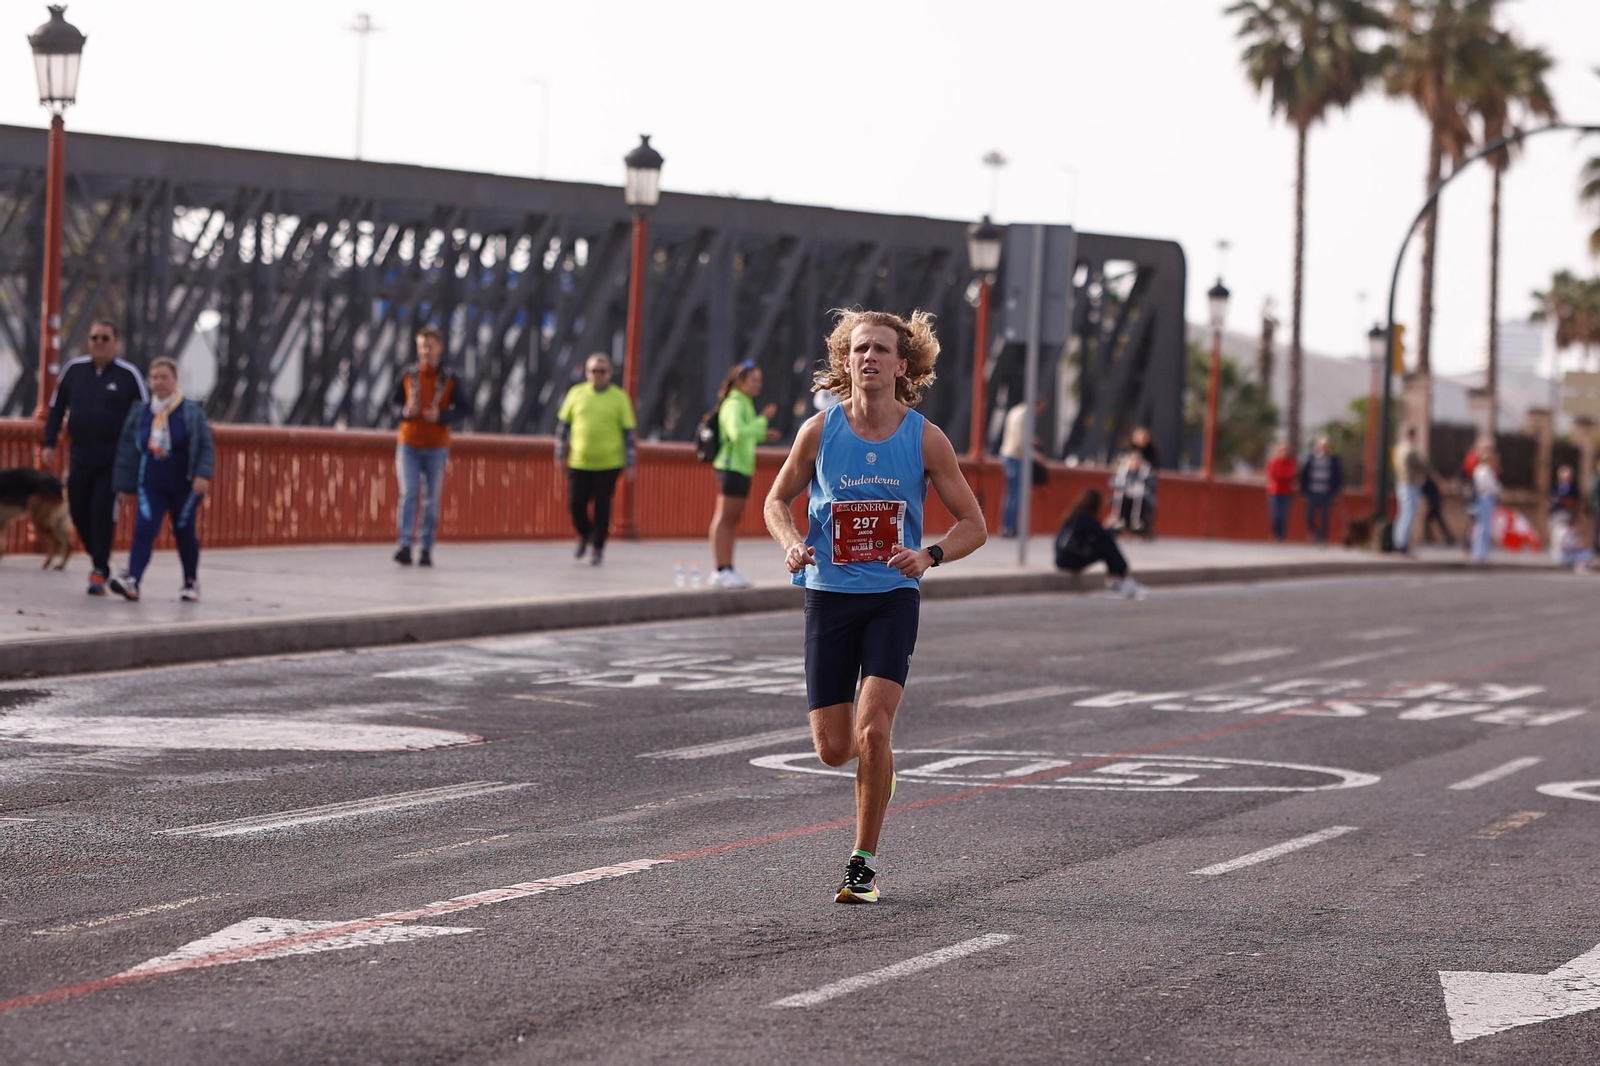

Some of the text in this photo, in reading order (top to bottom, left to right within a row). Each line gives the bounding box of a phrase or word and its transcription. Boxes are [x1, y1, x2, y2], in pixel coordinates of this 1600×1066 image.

[839, 474, 900, 490] Studenterna
[851, 502, 894, 512] GENERALI
[853, 517, 879, 530] 297
